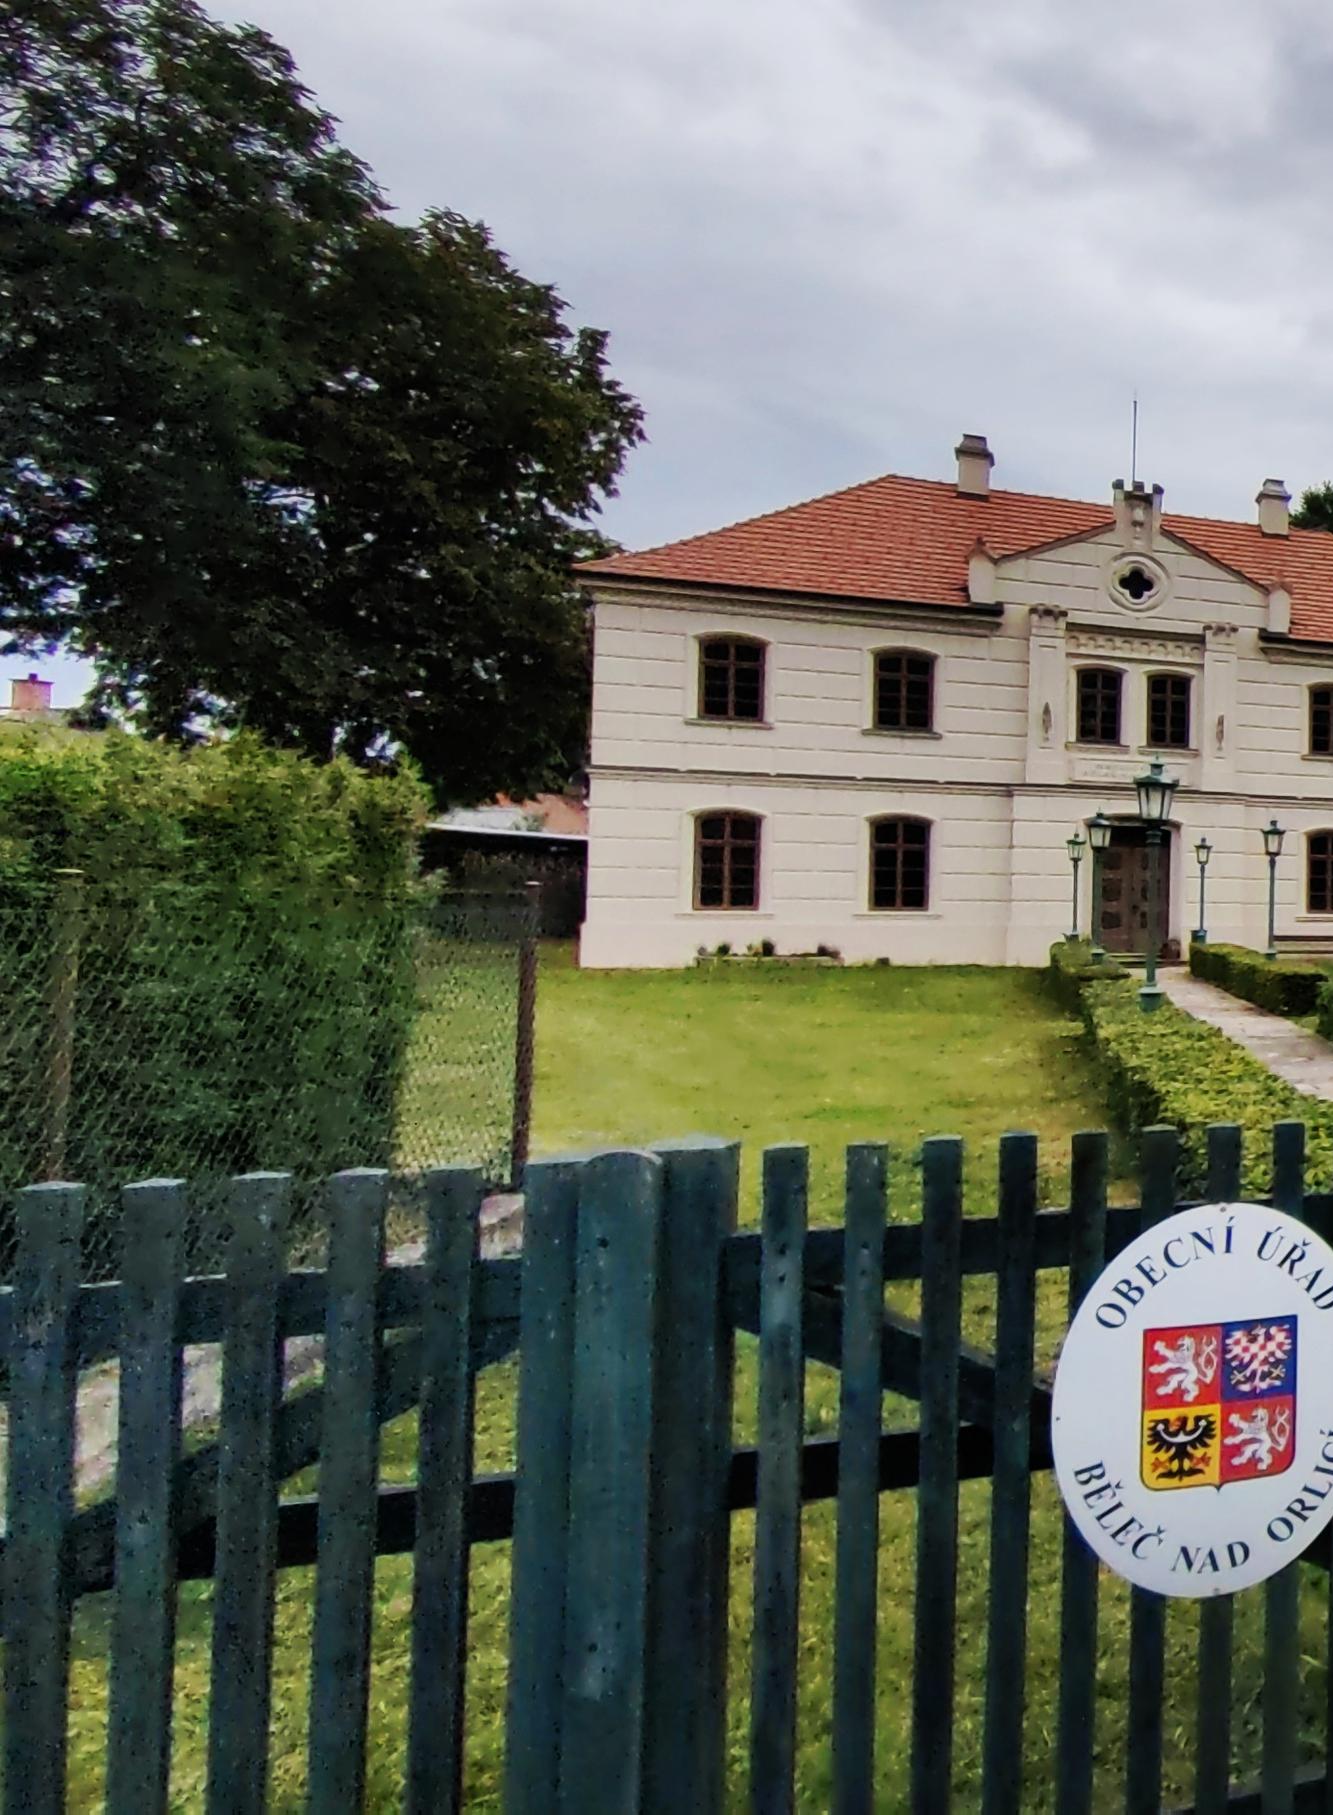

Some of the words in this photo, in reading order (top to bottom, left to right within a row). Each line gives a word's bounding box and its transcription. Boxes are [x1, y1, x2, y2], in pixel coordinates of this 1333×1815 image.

[1095, 1216, 1235, 1330] OBECNÍ
[1072, 1460, 1167, 1560] BĚLEČ
[1170, 1540, 1250, 1574] NAD
